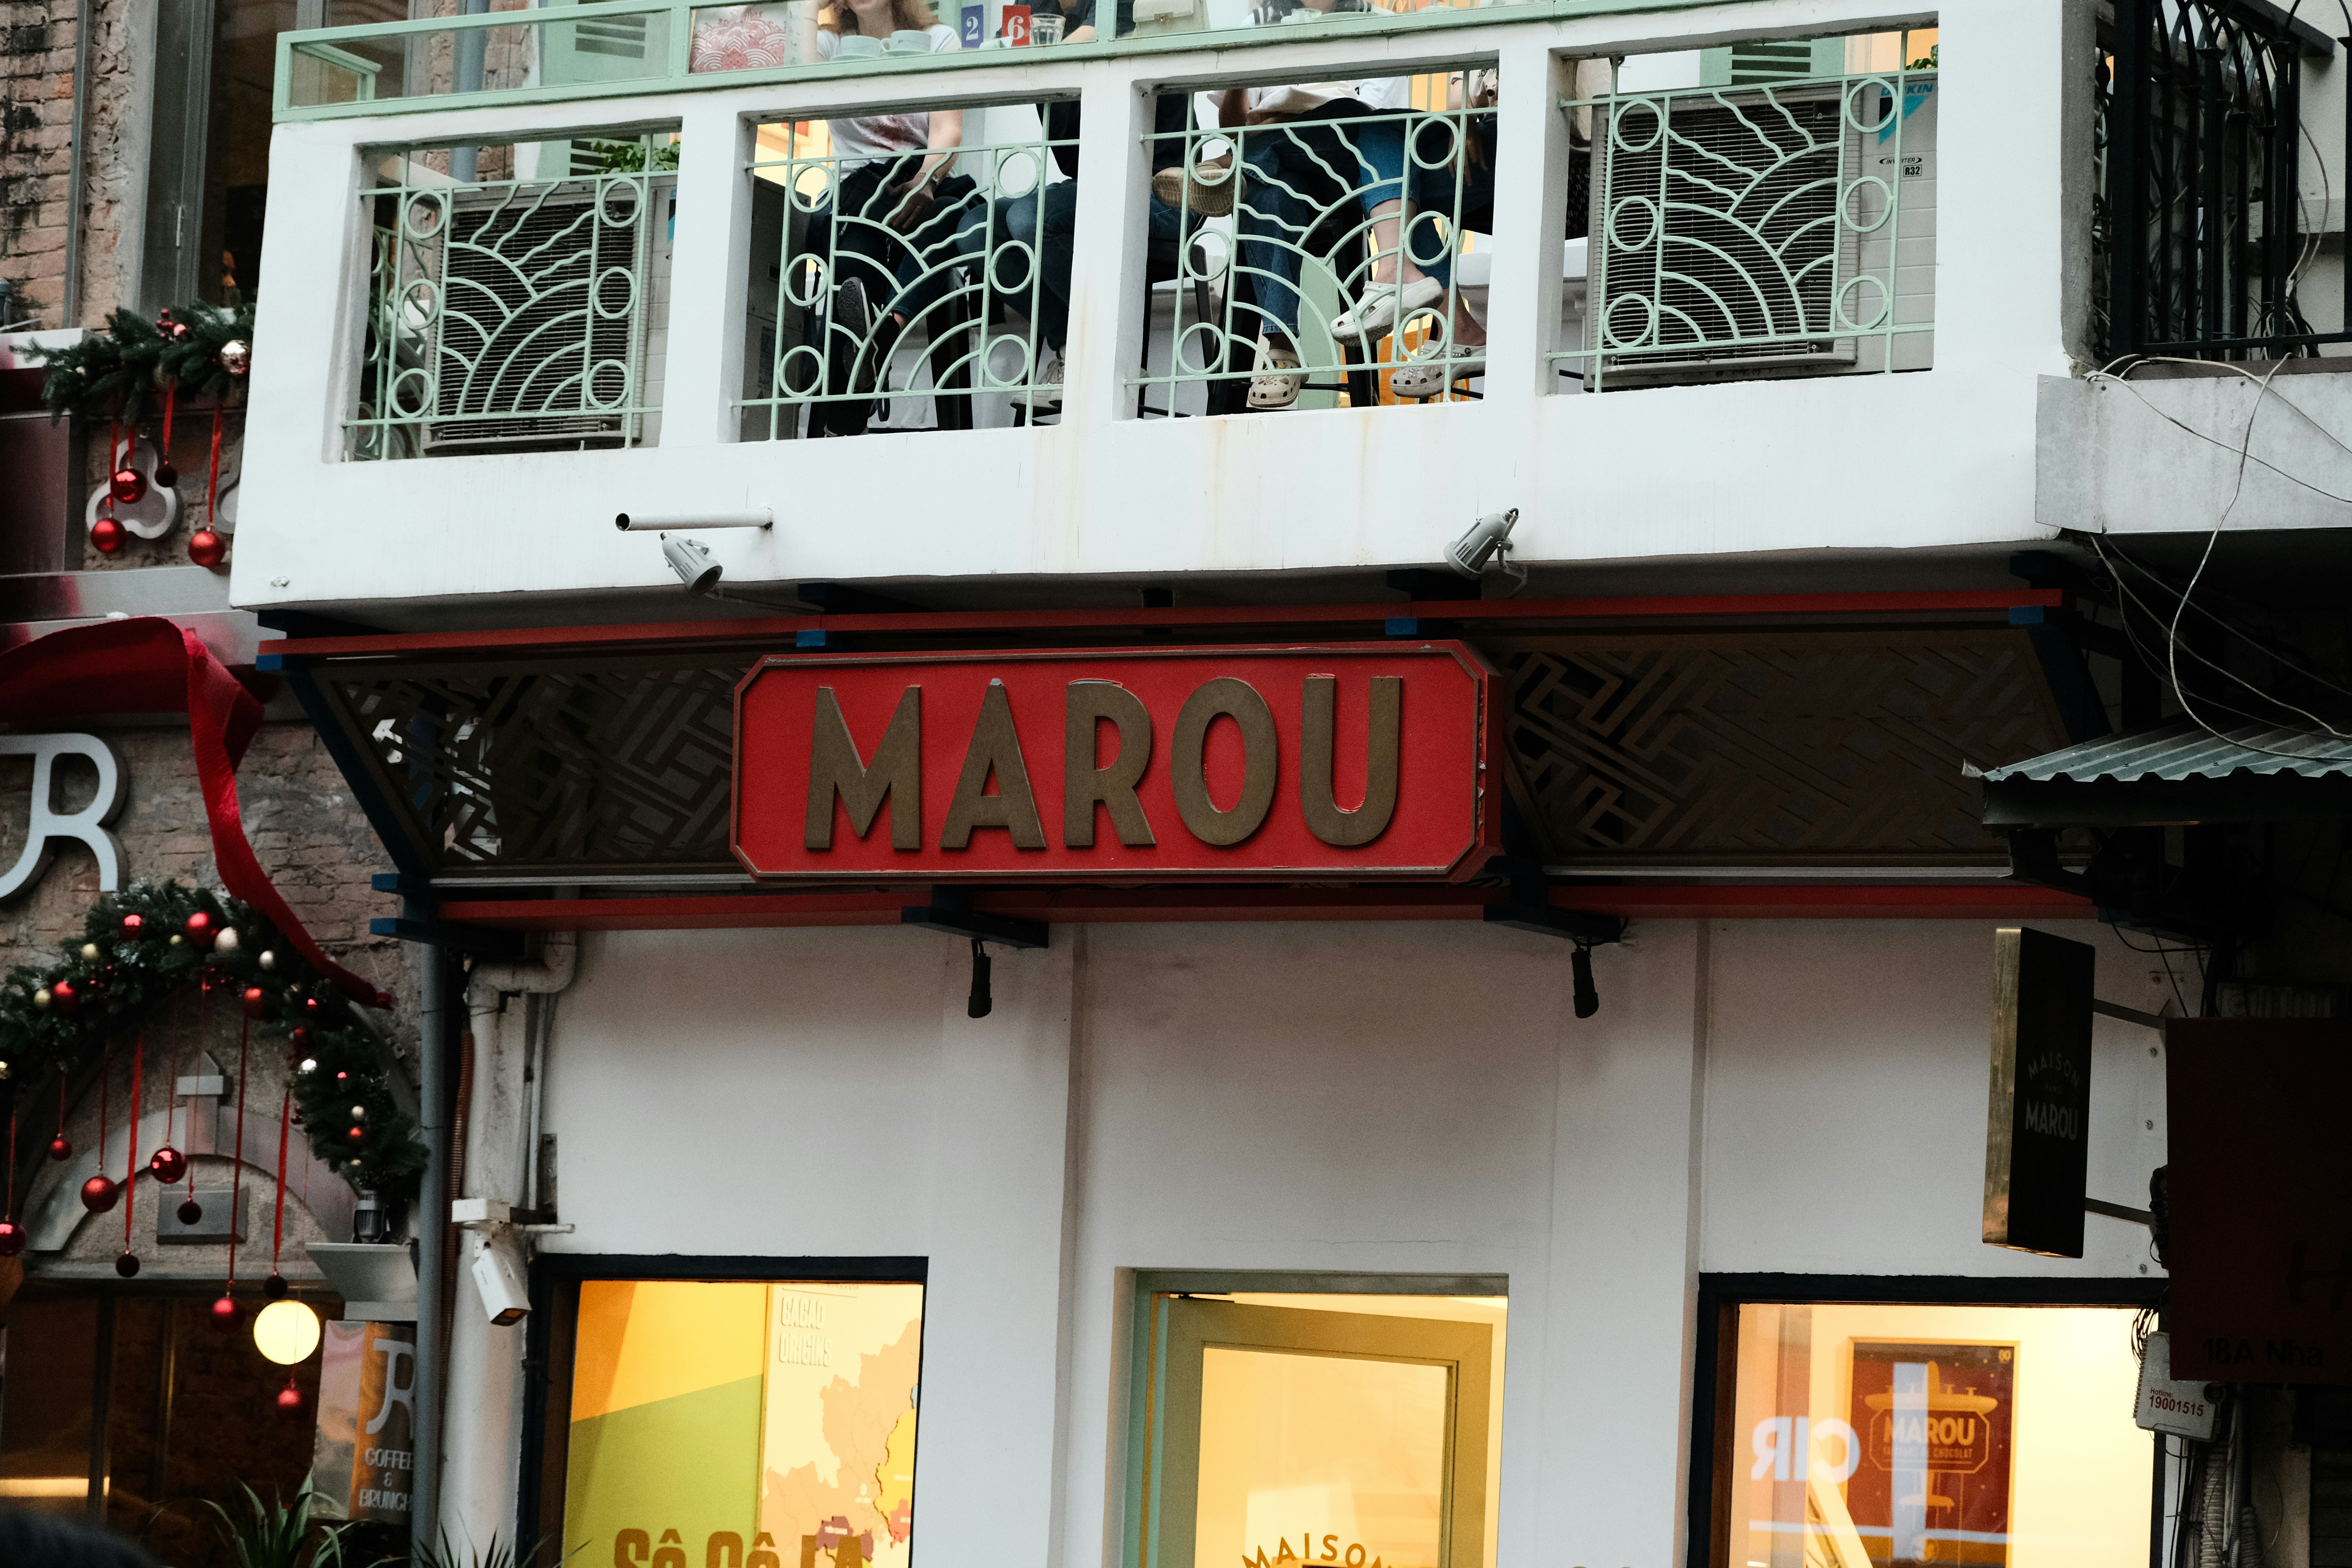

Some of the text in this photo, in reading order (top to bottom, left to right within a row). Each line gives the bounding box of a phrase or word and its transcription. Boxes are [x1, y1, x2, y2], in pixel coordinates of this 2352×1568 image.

[966, 17, 978, 40] 2
[1008, 15, 1024, 40] 6
[1905, 166, 1920, 175] R32
[804, 674, 1402, 850] MAROU
[2027, 1051, 2080, 1089] MAISON
[2025, 1097, 2078, 1141] MAROU
[779, 1332, 833, 1367] ORIGINS
[2202, 1337, 2254, 1364] 18A
[2149, 1395, 2204, 1416] 19001515
[1883, 1416, 1976, 1446] MAROU
[384, 1472, 392, 1487] &
